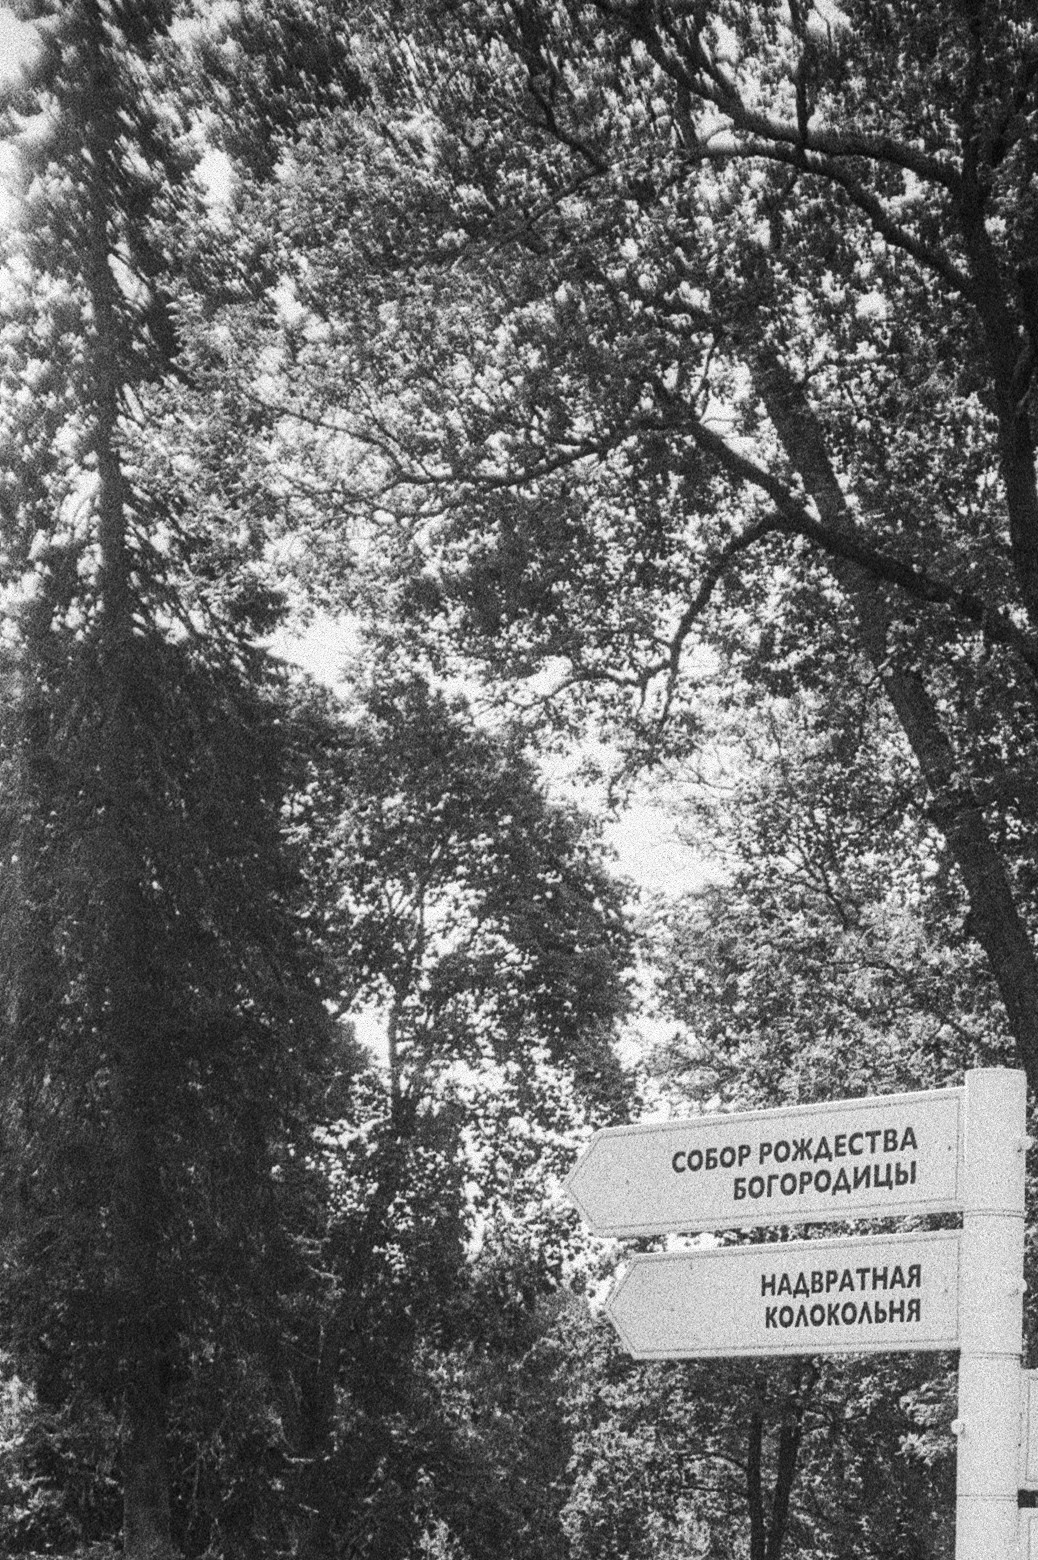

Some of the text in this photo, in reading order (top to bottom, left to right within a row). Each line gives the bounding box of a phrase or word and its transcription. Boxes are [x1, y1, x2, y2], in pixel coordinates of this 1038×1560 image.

[671, 1126, 919, 1174] СОБОР РОЖДЕСТВА
[732, 1160, 917, 1201] БОГОРОДИЦЫ
[760, 1263, 922, 1299] НАДВРАТНАЯ
[764, 1297, 922, 1329] КОЛОКОЛЬНЯ
